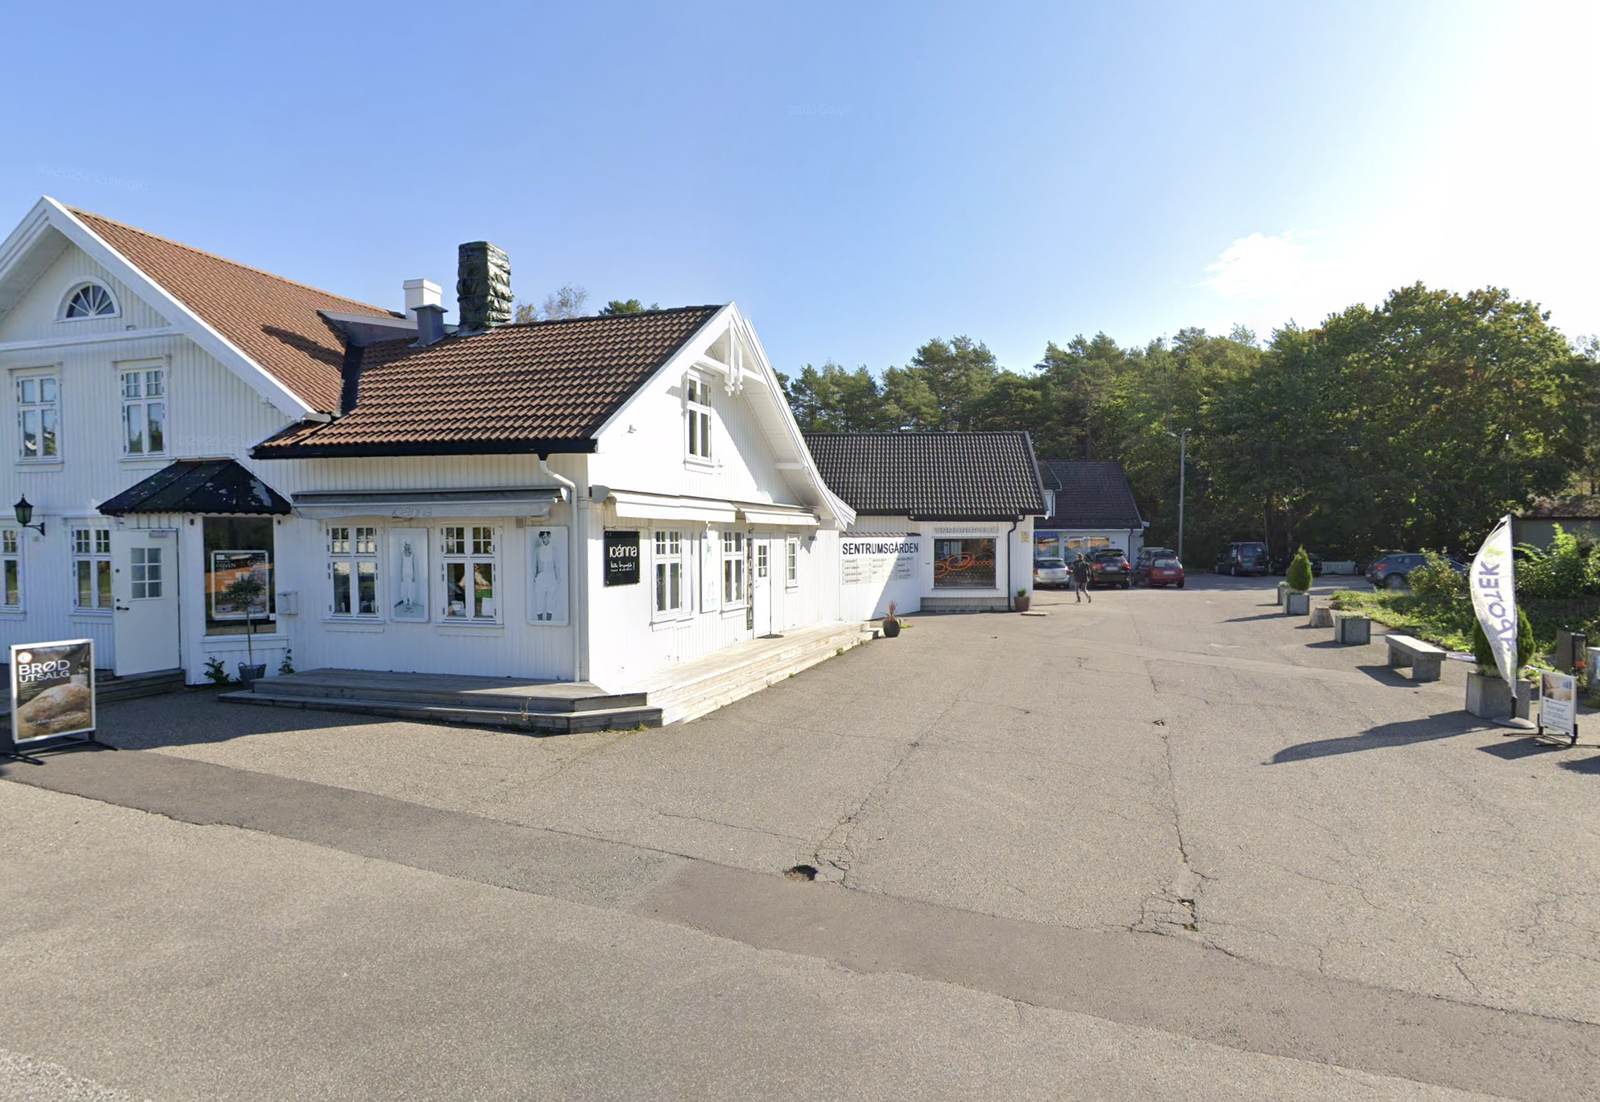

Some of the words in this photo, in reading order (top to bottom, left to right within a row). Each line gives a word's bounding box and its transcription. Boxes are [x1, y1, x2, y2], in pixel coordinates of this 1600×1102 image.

[842, 542, 919, 555] SENTRUMSGÅRDEN
[19, 660, 70, 676] BRØD
[19, 670, 70, 683] UTSALG
